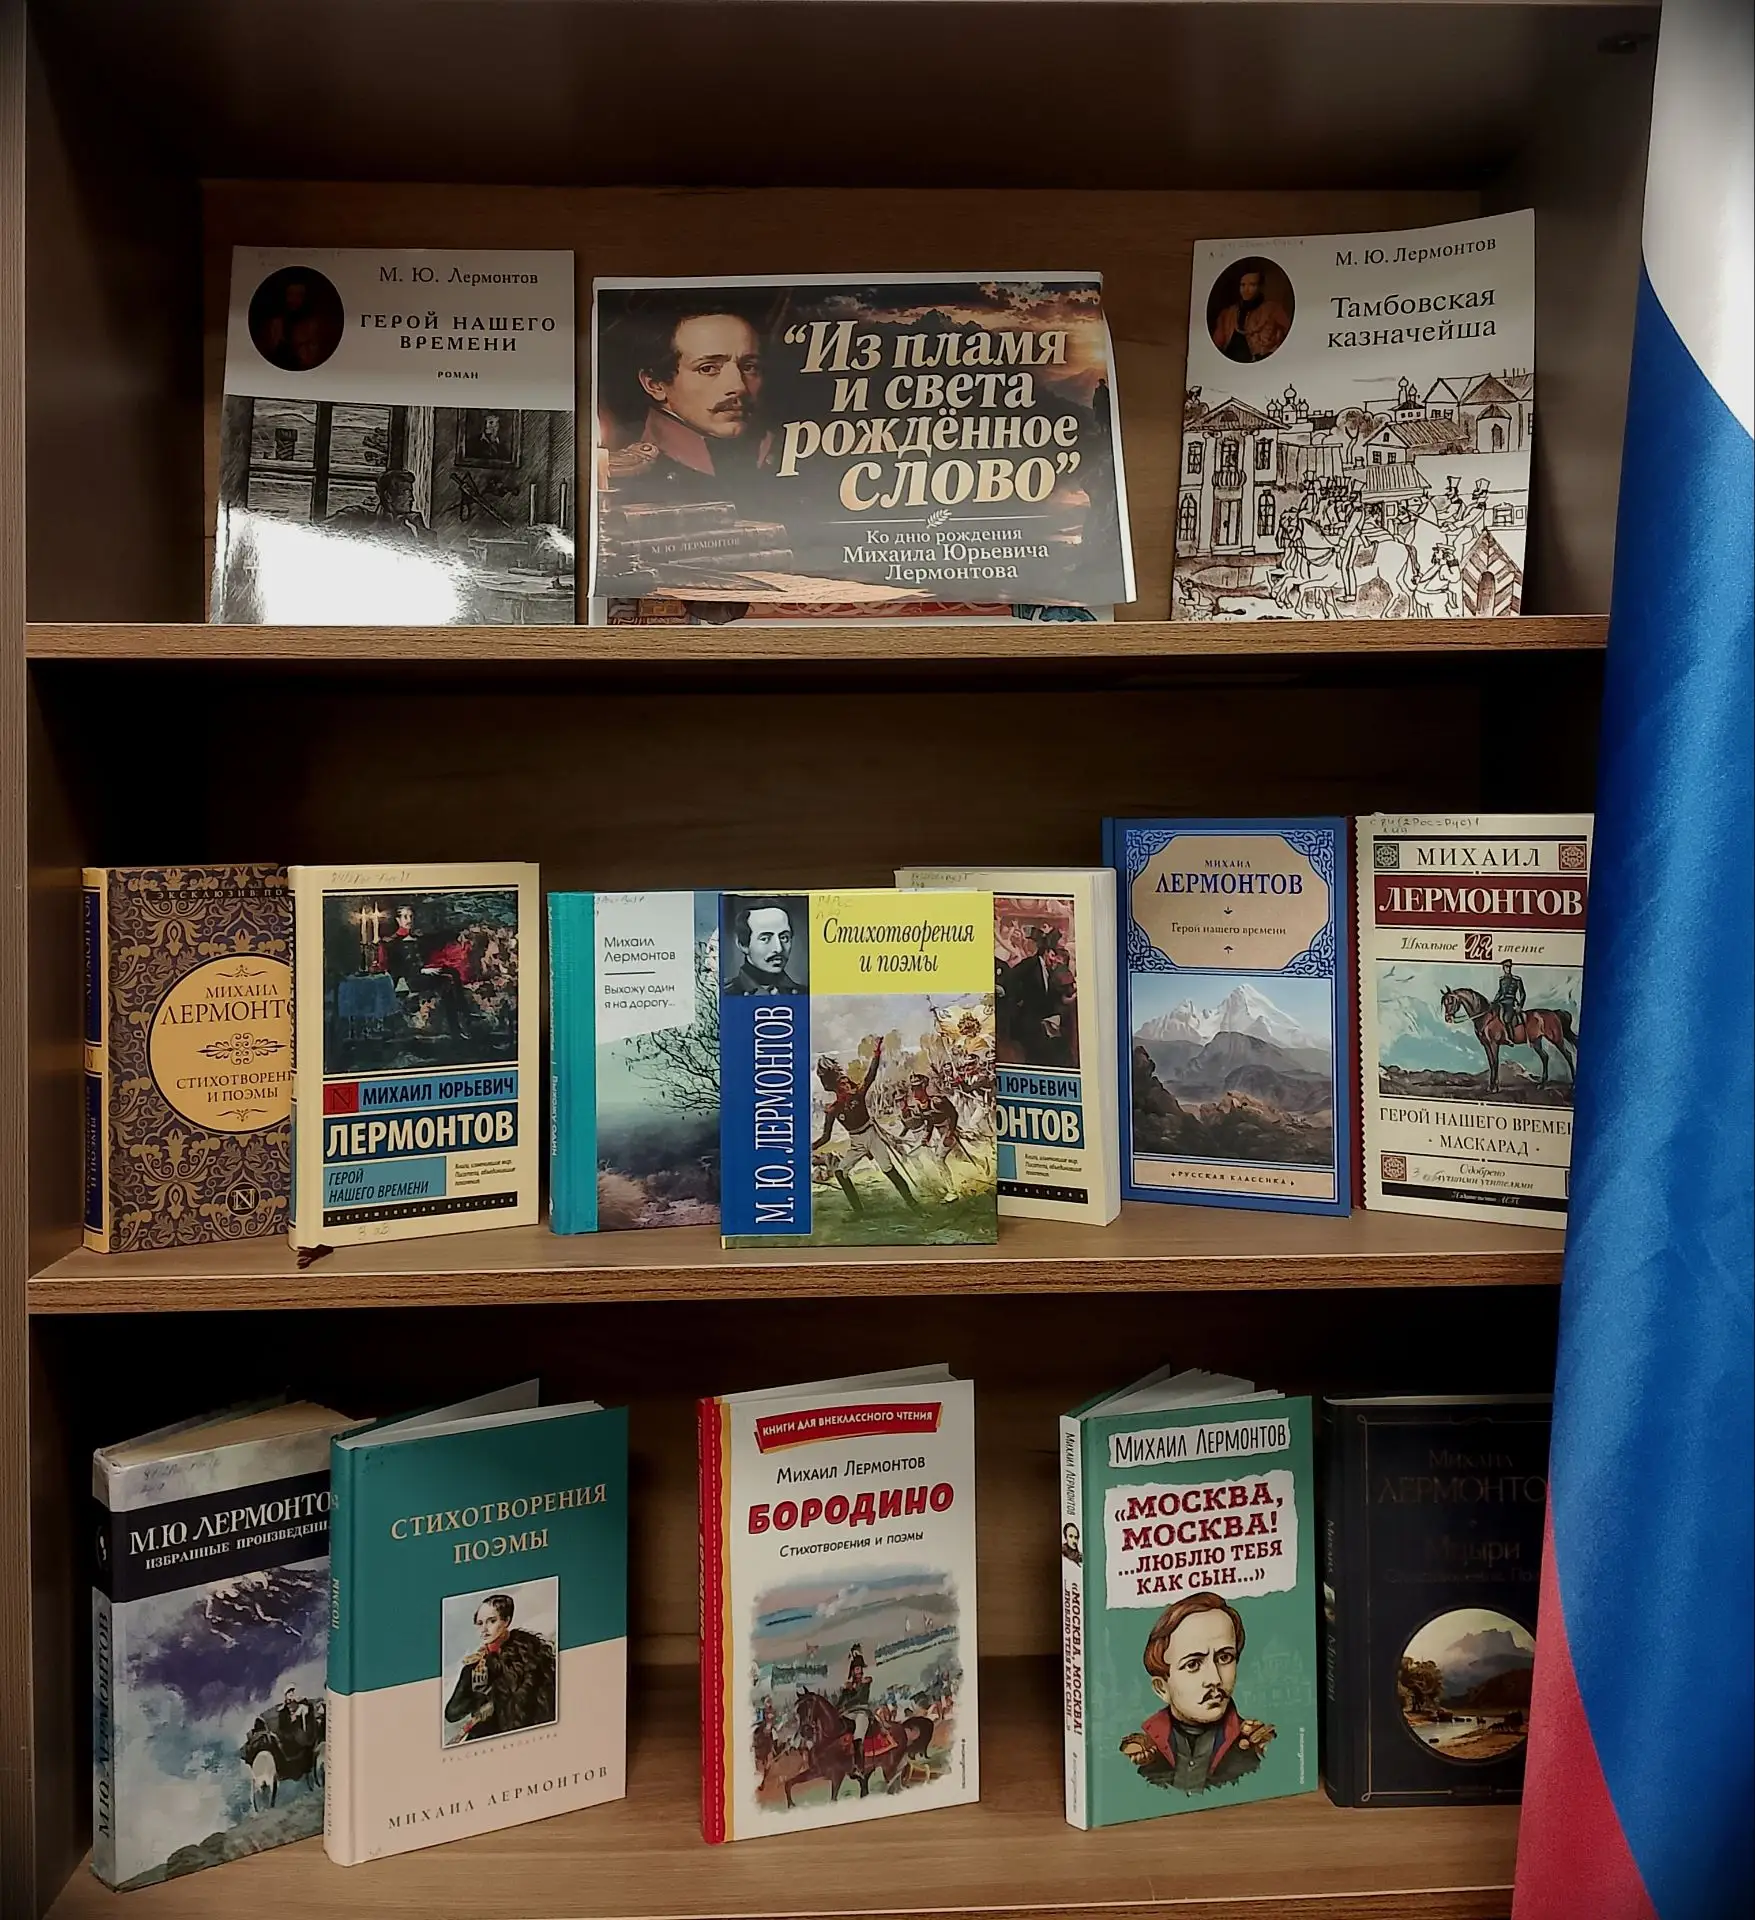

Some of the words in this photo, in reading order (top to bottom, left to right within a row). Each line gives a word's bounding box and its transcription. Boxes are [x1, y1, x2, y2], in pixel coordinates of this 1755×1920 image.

[1335, 250, 1358, 266] М.
[1364, 248, 1389, 265] Ю.
[1393, 237, 1497, 264] Лермонтов
[379, 266, 403, 283] М.
[411, 267, 440, 284] Ю.
[448, 267, 539, 287] Лермонтов
[1330, 288, 1496, 319] Тамбовская
[360, 311, 440, 331] ГЕРОЙ
[452, 316, 556, 332] НАШЕГО
[1328, 319, 1497, 348] казначейша
[400, 335, 518, 352] ВРЕМЕНИ
[892, 330, 1068, 368] пламя
[437, 371, 479, 380] РОМАН
[831, 377, 871, 412] и
[884, 371, 1036, 410] света
[776, 407, 1079, 477] рождённое
[866, 530, 889, 544] Ко
[894, 531, 931, 545] дню
[936, 529, 1023, 545] рождения
[842, 547, 936, 563] Михаила
[943, 543, 1049, 564] Юрьевича
[885, 564, 1018, 584] Лермонтова
[1205, 860, 1251, 868] МИХАИЛ
[1417, 848, 1541, 866] МИХАИЛ
[157, 889, 257, 899] ЭКСКЛЮЗИВ
[1155, 873, 1303, 894] ЛЕРМОНТОВ
[1378, 887, 1583, 916] ЛЕРМОНТОВ
[604, 937, 655, 948] Михаил
[823, 917, 975, 951] Стихотворения
[1203, 926, 1239, 934] нашего
[1242, 927, 1286, 936] времени
[1400, 937, 1458, 950] Школьное
[604, 950, 676, 962] Лермонтов
[860, 958, 872, 972] и
[876, 954, 938, 972] поэмы
[206, 984, 278, 999] МИХАИЛ
[604, 984, 646, 996] Выхожу
[649, 984, 675, 994] один
[160, 999, 292, 1025] ЛЕРМОНТ
[176, 1071, 292, 1089] СТИХОТВОРЕН
[363, 1083, 432, 1106] МИХАИЛ
[439, 1077, 514, 1100] ЮРЬЕВИЧ
[754, 1006, 794, 1154] ЛЕРМОНТОВ
[1006, 1076, 1078, 1098] ЮРЬЕВИЧ
[207, 1092, 217, 1103] И
[222, 1087, 278, 1102] ПОЭМЫ
[327, 1110, 514, 1157] ЛЕРМОНТОВ
[996, 1104, 1080, 1143] ОНТОВ
[1380, 1107, 1430, 1124] ГЕРОЙ
[1435, 1113, 1507, 1130] НАШЕГО
[1513, 1118, 1571, 1135] ВРЕМЕ
[1440, 1135, 1529, 1157] МАСКАРАД
[329, 1168, 364, 1186] ГЕРОЙ
[1178, 1171, 1225, 1180] РУССКАЯ
[1230, 1174, 1287, 1185] КЛАССИКА
[1460, 1164, 1506, 1178] Одобрено
[329, 1186, 374, 1203] НАШЕГО
[378, 1181, 429, 1198] ВРЕМЕНИ
[762, 1422, 795, 1436] КНИГИ
[797, 1418, 817, 1430] ДЛЯ
[819, 1411, 894, 1427] ВНЕКЛАССНОГО
[896, 1411, 933, 1421] ЧТЕНИЯ
[1115, 1482, 1284, 1522] «МОСКВА,
[1378, 1475, 1547, 1504] ЛЕРМОНТО
[192, 1491, 331, 1541] ЛЕРМОНТО
[391, 1483, 608, 1540] СТИХОТВОРЕНИЯ
[748, 1482, 955, 1535] БОРОДИНО
[1122, 1511, 1278, 1552] МОСКВА!
[145, 1542, 230, 1570] ИЗБРАННЫЕ
[236, 1520, 328, 1549] ПРОИЗВЕДЕНИ
[453, 1528, 549, 1565] ПОЭМЫ
[1118, 1546, 1225, 1576] ...ЛЮБЛЮ
[1230, 1539, 1283, 1561] ТЕБЯ
[1136, 1574, 1183, 1596] КАК
[1188, 1567, 1265, 1589] СЫН...»
[97, 1611, 110, 1778] ЛЕРМОНТОВ
[1073, 1664, 1083, 1736] МОСКВА!
[388, 1800, 475, 1829] МИХАИЛ
[488, 1766, 608, 1806] ЛЕРМОНТОВ
